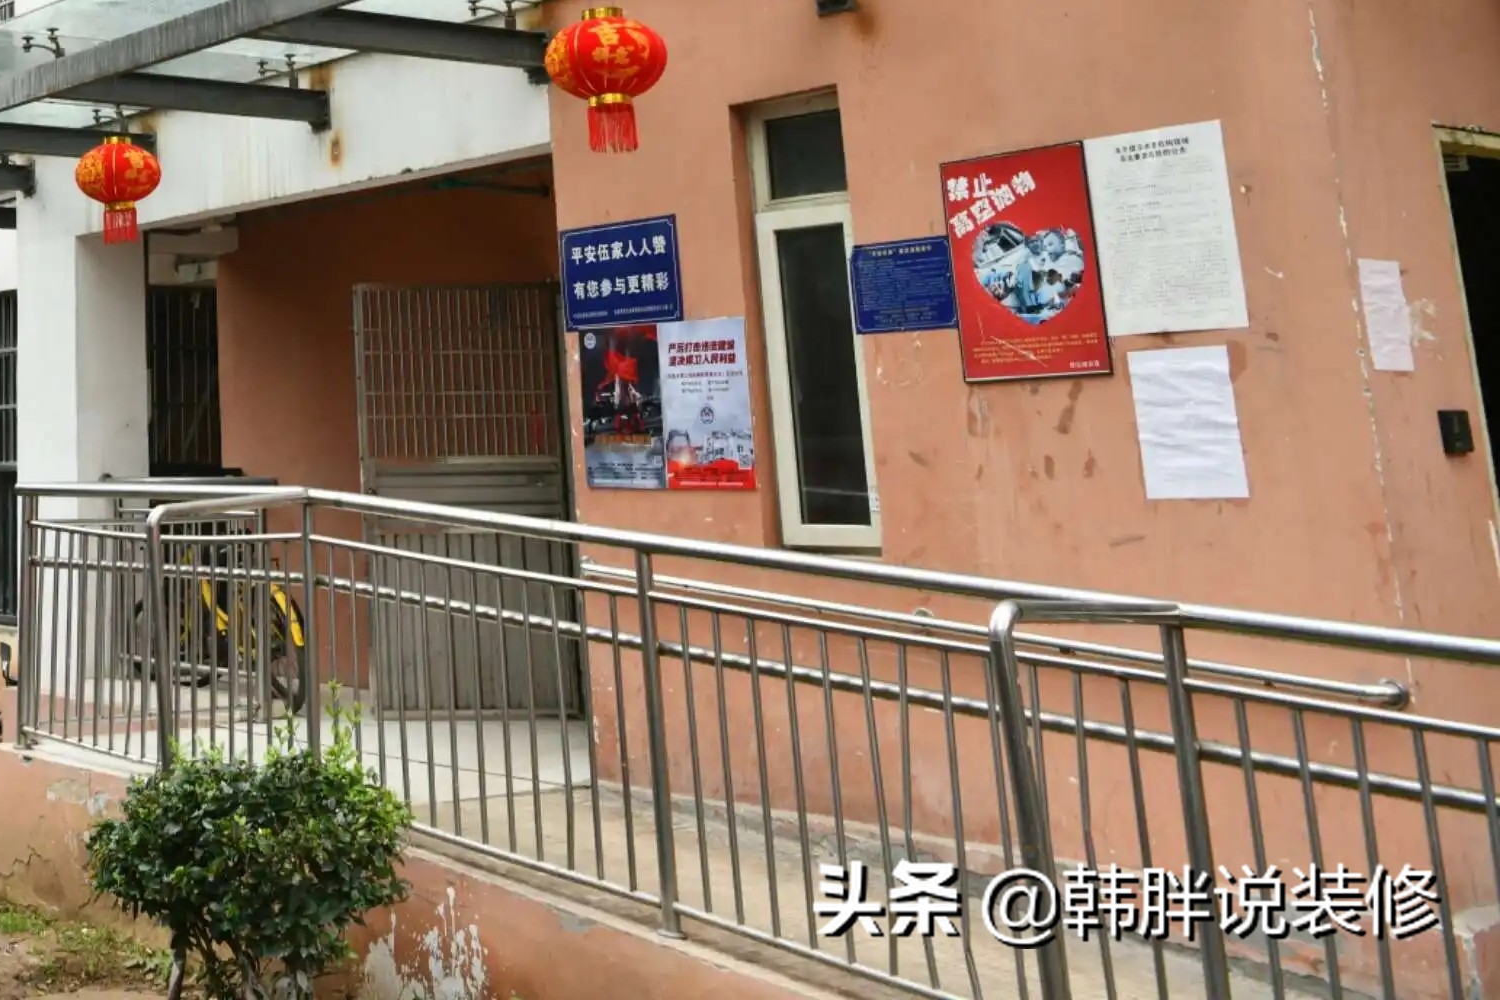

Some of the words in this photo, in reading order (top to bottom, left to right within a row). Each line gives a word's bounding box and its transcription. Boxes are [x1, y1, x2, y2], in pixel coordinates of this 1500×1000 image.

[947, 172, 993, 202] 禁止
[949, 170, 1037, 239] 高空抛物
[571, 235, 667, 265] 平安伍家人人赞
[573, 271, 670, 300] 有您参与更精彩
